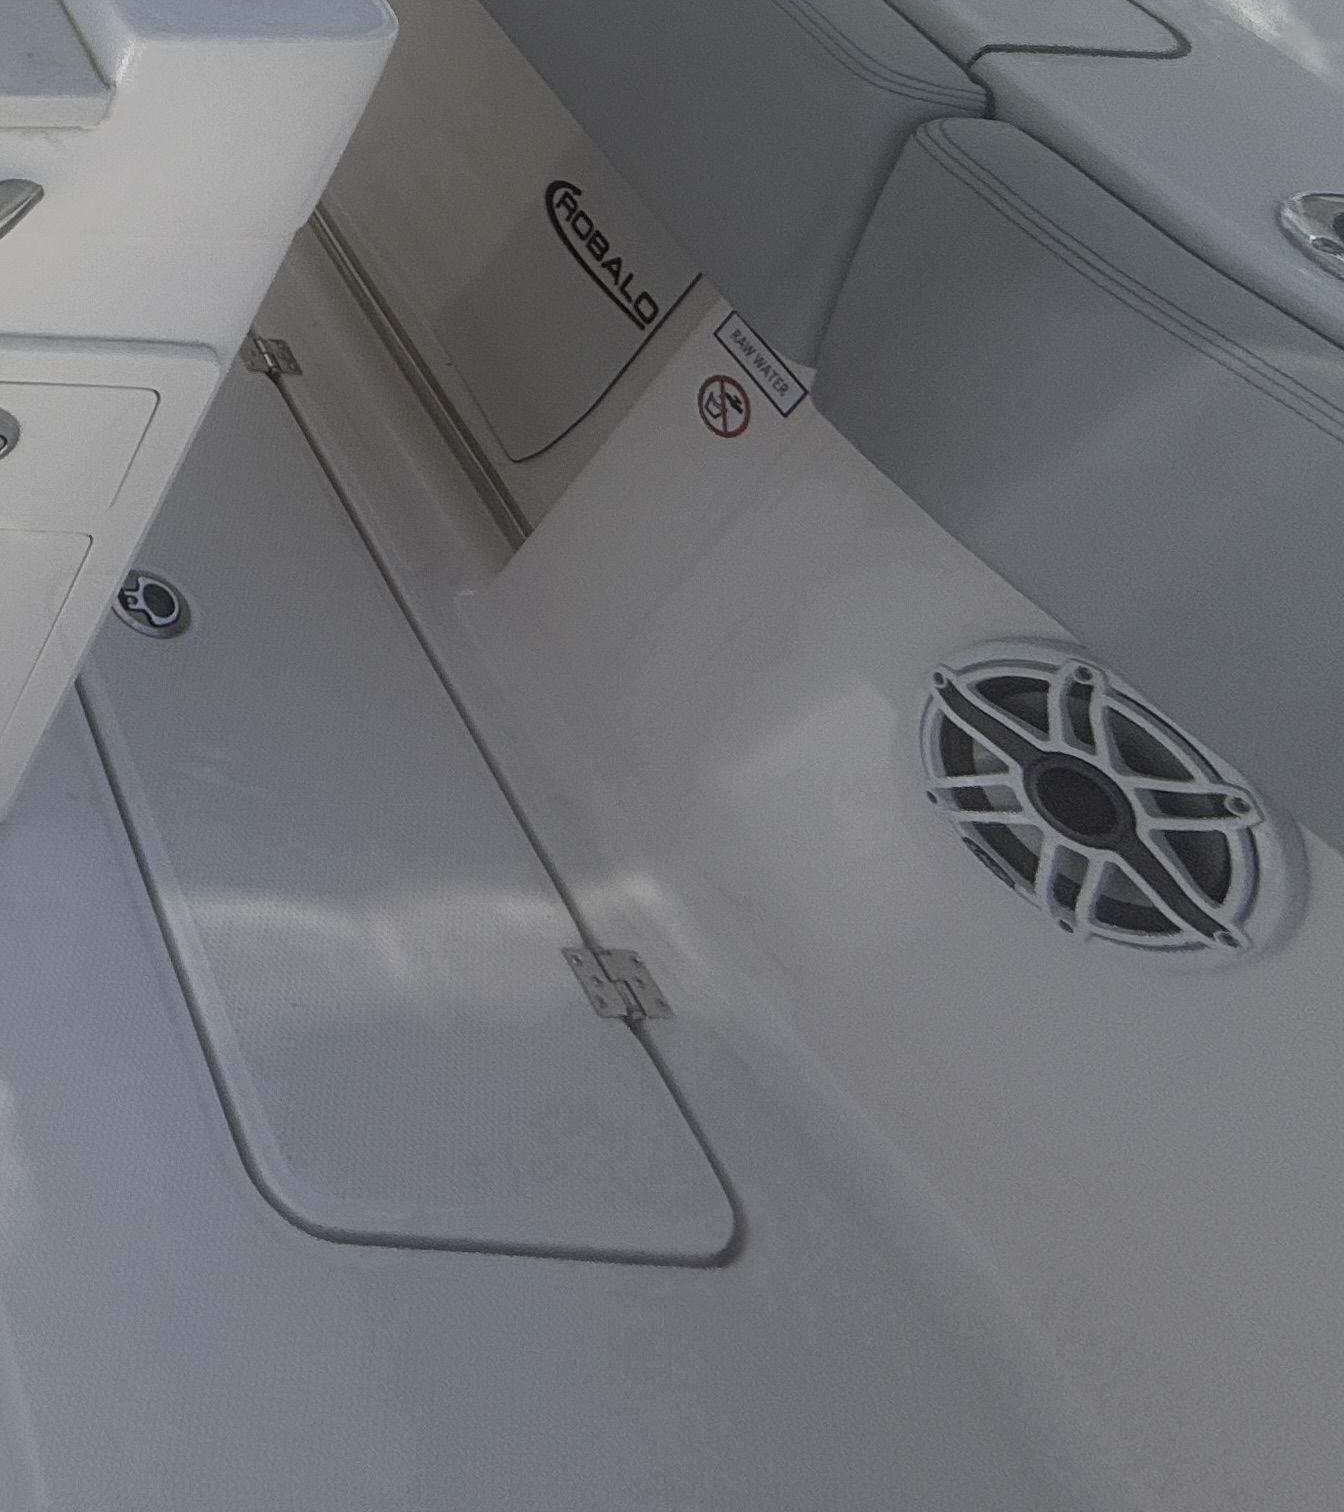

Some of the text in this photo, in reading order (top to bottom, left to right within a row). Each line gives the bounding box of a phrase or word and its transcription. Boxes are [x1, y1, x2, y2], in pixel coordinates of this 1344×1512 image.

[555, 190, 660, 325] ROBALO
[729, 329, 790, 397] RAW WATER
